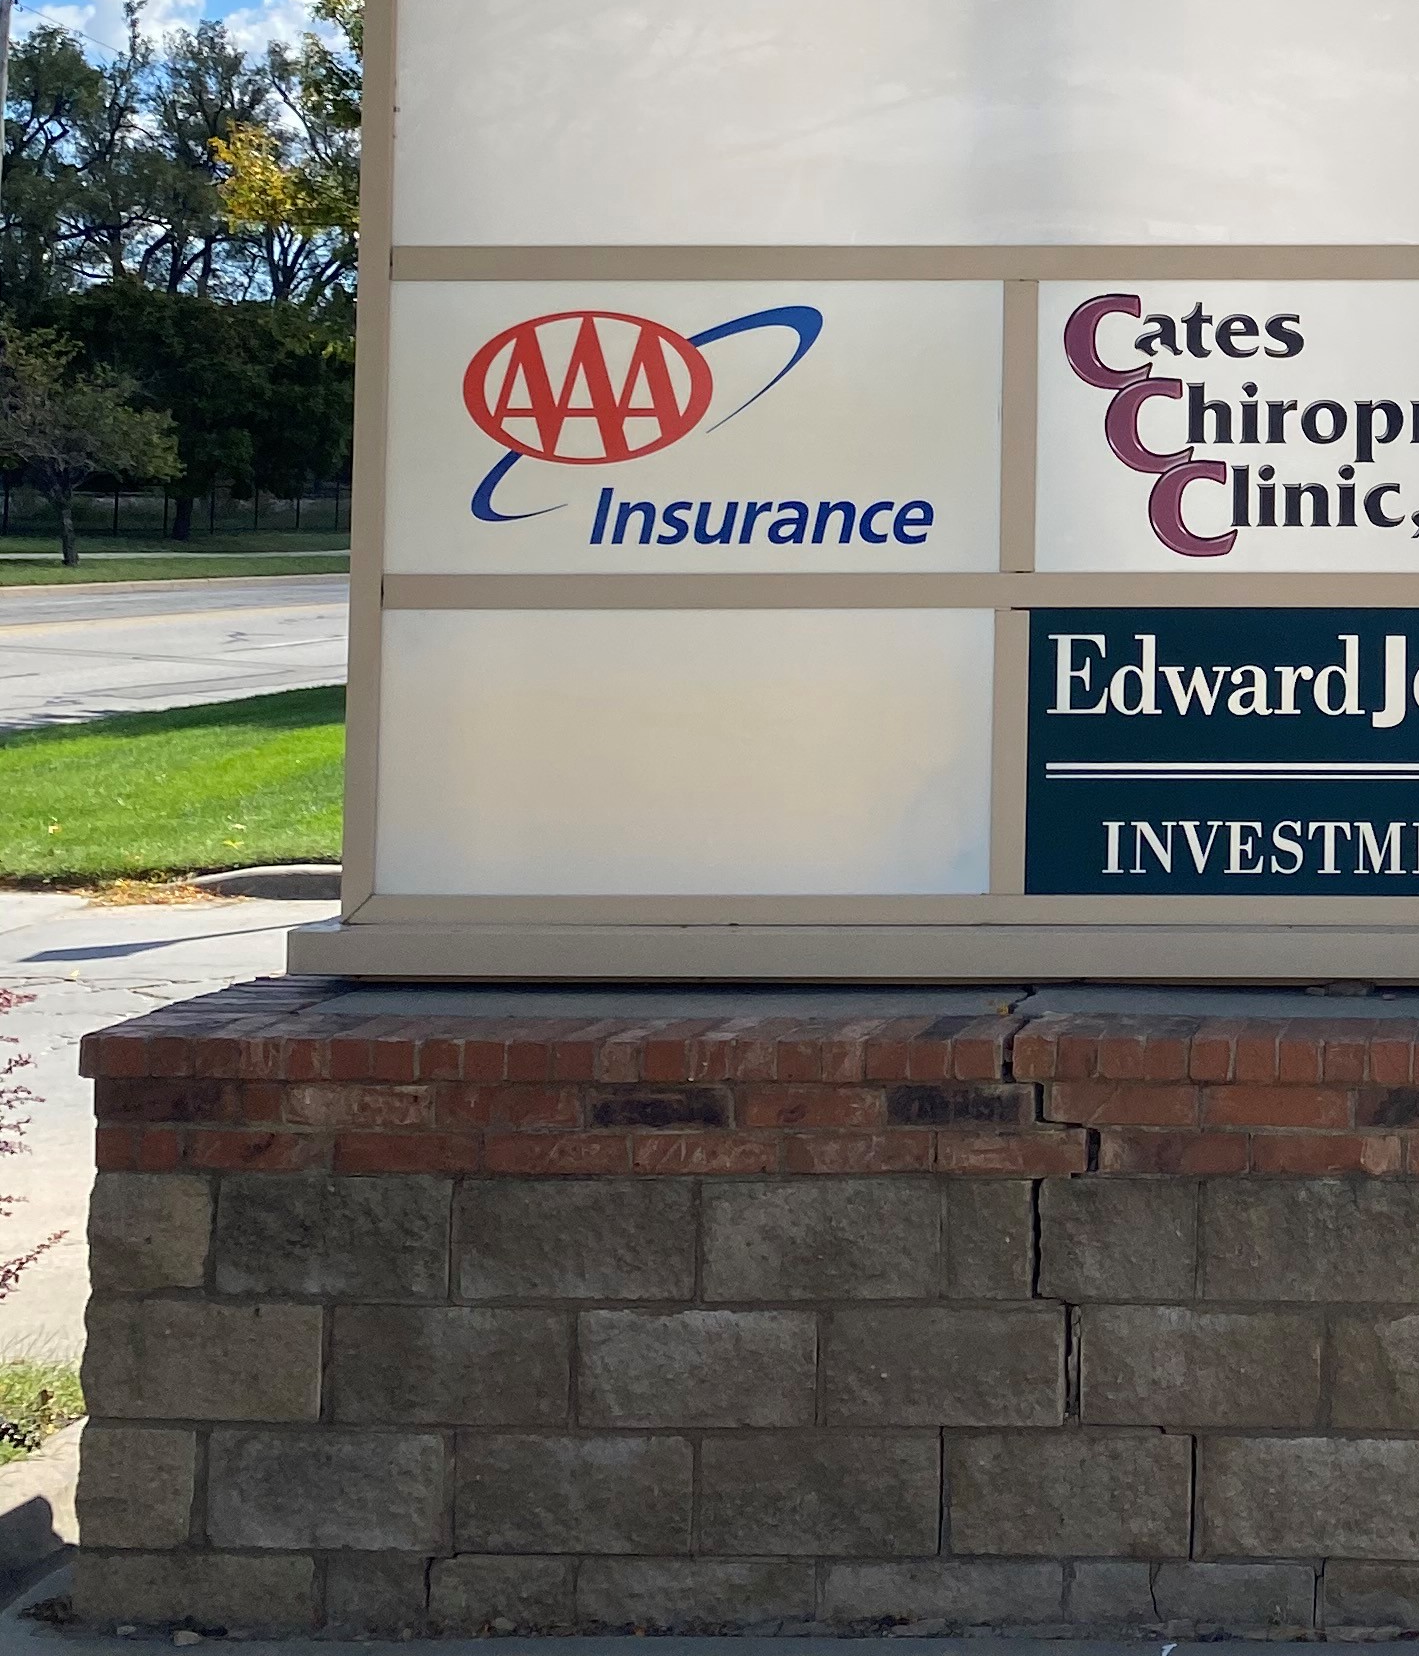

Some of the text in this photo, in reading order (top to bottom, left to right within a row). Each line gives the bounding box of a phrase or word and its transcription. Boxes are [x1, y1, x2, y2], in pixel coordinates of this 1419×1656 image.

[488, 313, 683, 459] AAA
[1064, 294, 1305, 390] Cates
[589, 488, 933, 548] Insurance
